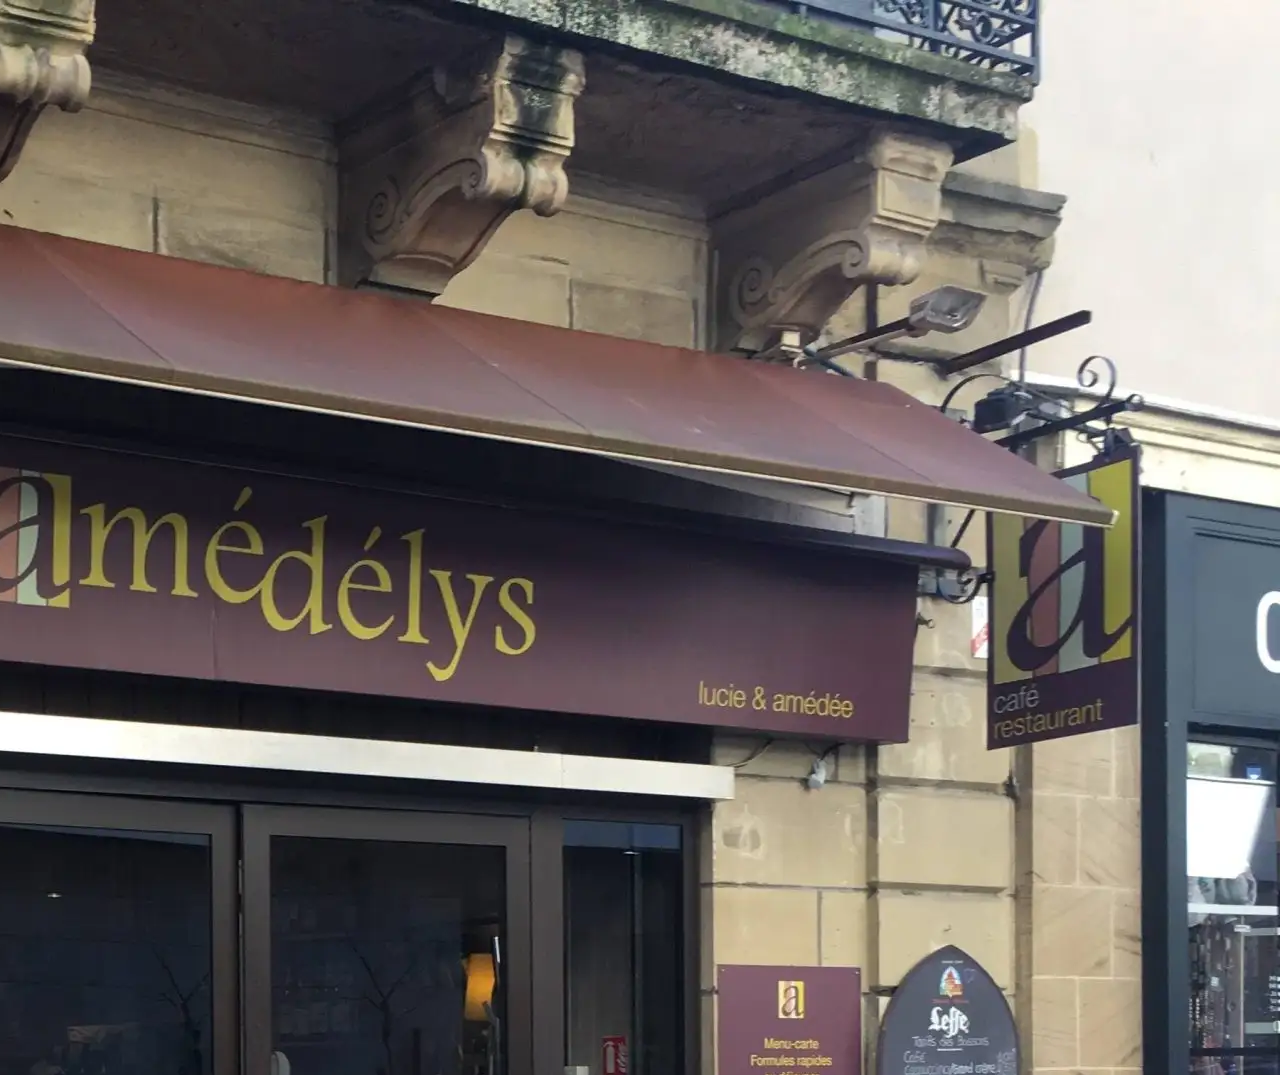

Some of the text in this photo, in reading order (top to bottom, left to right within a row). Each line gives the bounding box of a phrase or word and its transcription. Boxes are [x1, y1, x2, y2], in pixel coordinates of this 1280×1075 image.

[698, 681, 855, 718] lucie & amédée
[993, 683, 1040, 714] café
[993, 698, 1104, 740] restaurant
[928, 1006, 970, 1038] Leffe
[764, 1038, 820, 1049] Menu-carte
[750, 1055, 833, 1068] Formules rapides
